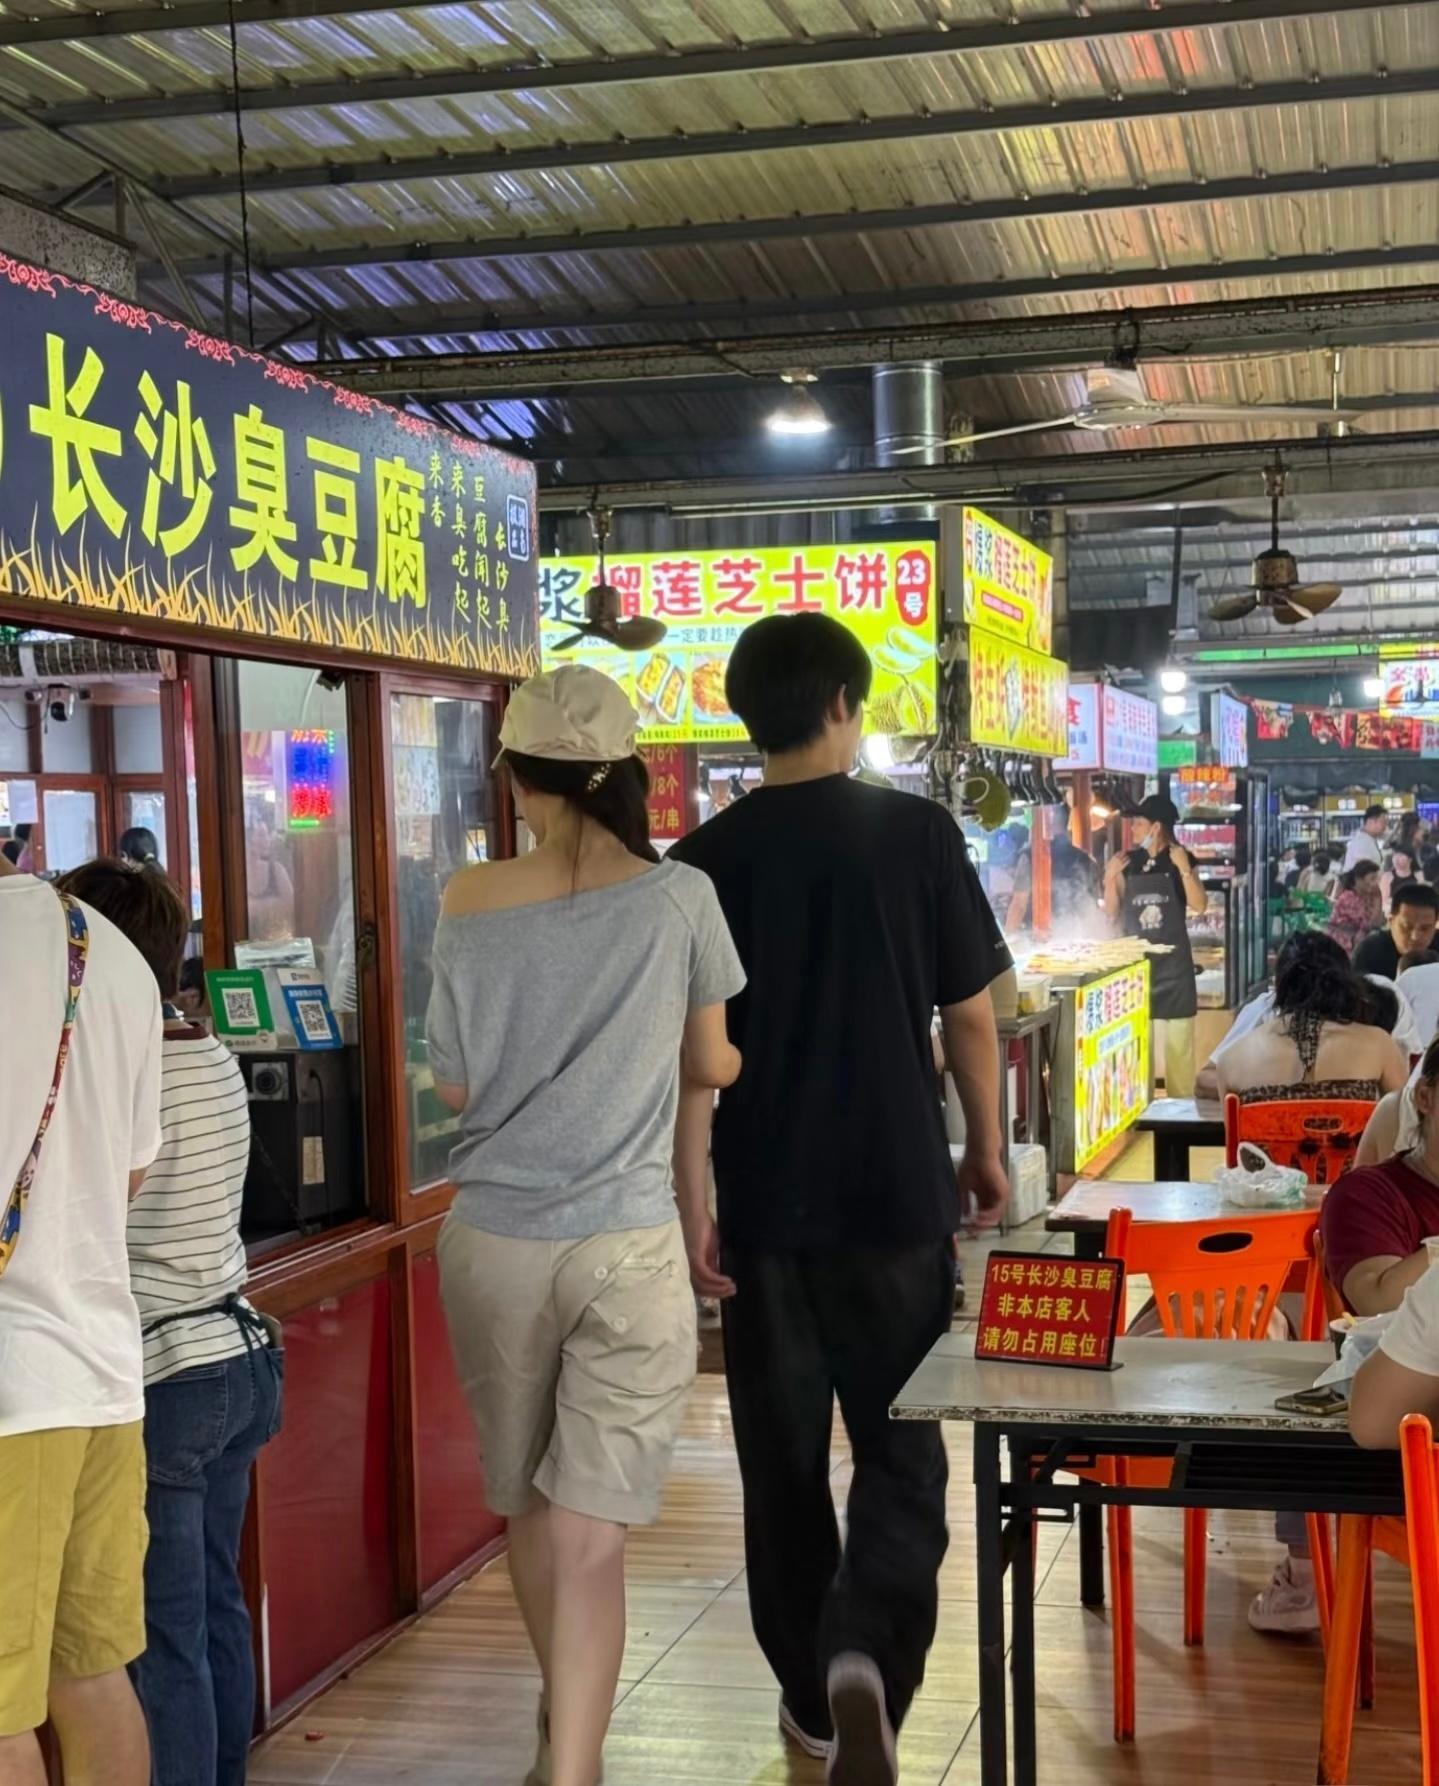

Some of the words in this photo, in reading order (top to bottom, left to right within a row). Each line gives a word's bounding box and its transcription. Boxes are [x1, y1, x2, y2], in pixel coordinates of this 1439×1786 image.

[29, 332, 426, 608] 长沙臭豆腐
[429, 451, 446, 528] 来香
[473, 475, 492, 630] 豆腐闻起
[897, 558, 926, 585] 23
[904, 592, 923, 618] 号
[991, 1263, 1114, 1291] 15号长沙臭豆腐
[997, 1292, 1091, 1322] 非本店客人
